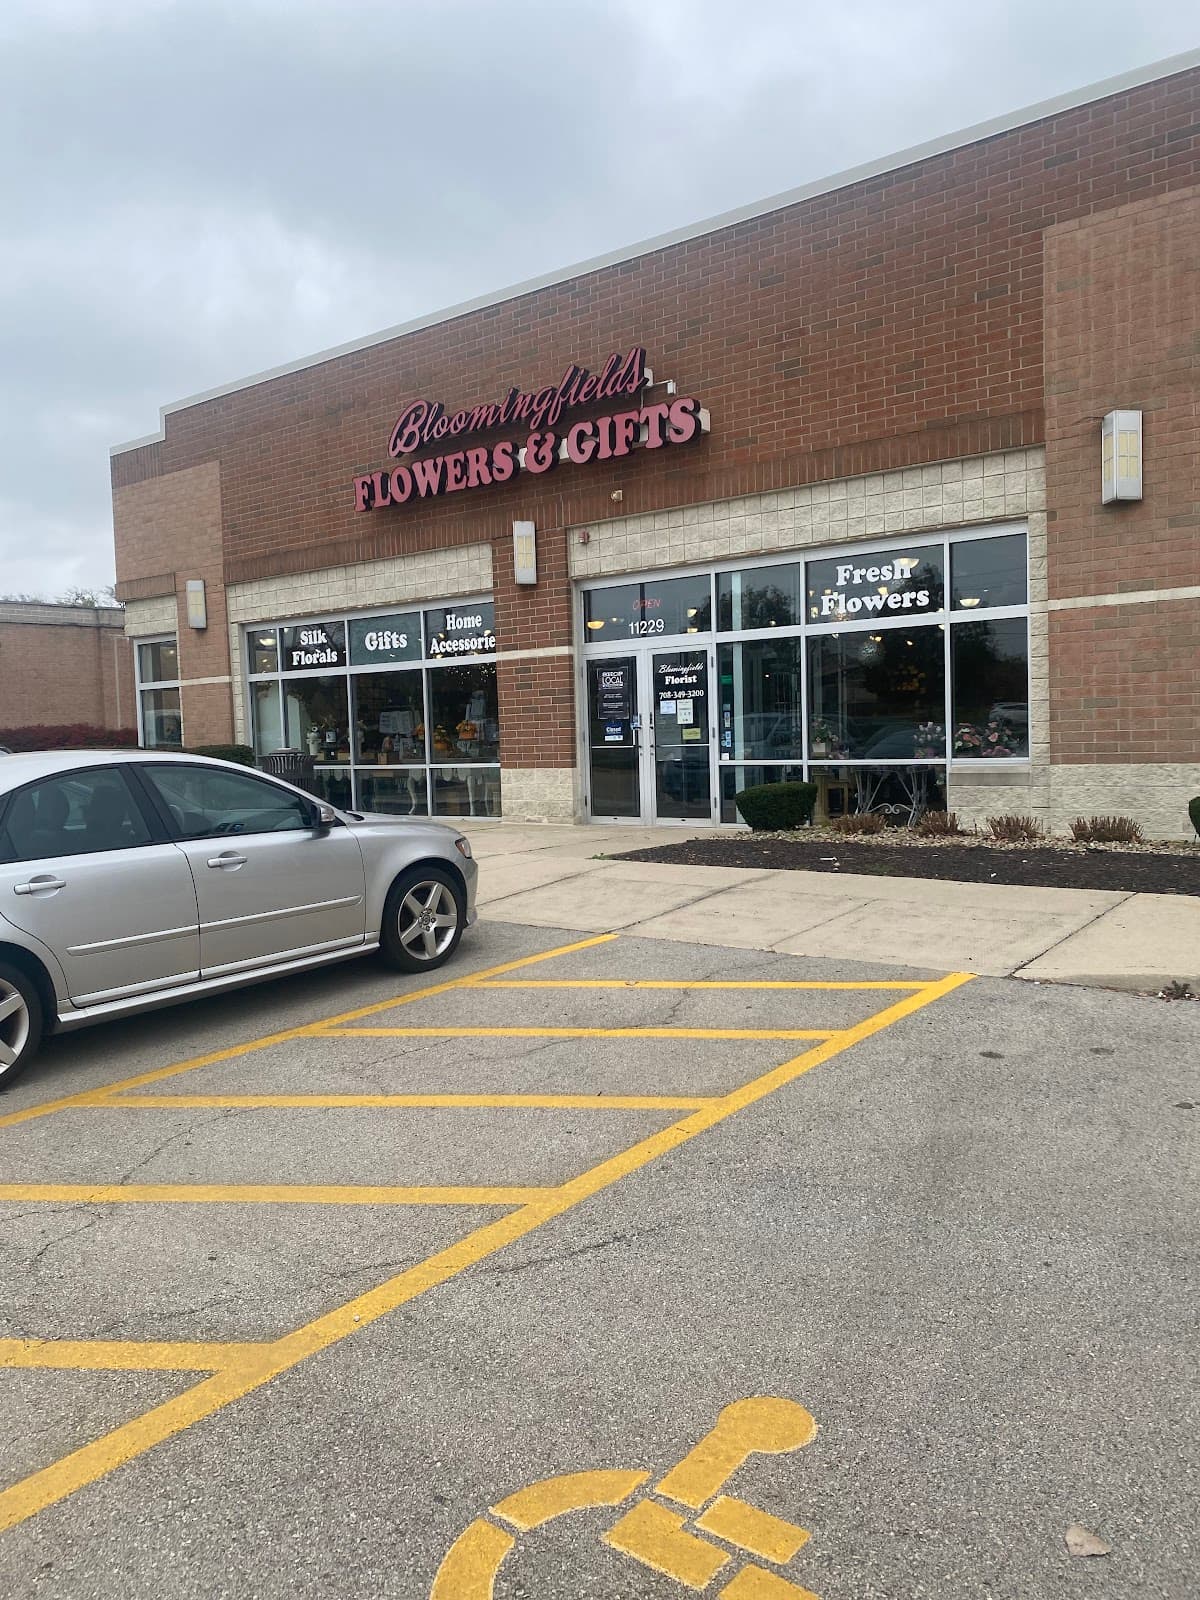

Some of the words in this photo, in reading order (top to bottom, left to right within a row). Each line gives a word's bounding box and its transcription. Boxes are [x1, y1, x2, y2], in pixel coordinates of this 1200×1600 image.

[388, 347, 646, 458] Bloomingfields
[354, 441, 516, 512] FLOWERS
[524, 432, 559, 474] &
[567, 398, 699, 464] GIFTS
[836, 558, 911, 586] Fresh
[633, 599, 662, 609] OPEN
[820, 589, 930, 616] Flowers
[446, 614, 482, 630] Home
[629, 619, 664, 634] 11229
[300, 630, 327, 645] Silk
[365, 631, 407, 651] Gifts
[430, 636, 495, 654] Accessorie
[292, 650, 338, 665] Florals
[665, 675, 697, 685] Florist
[659, 690, 704, 699] 708-349-3200
